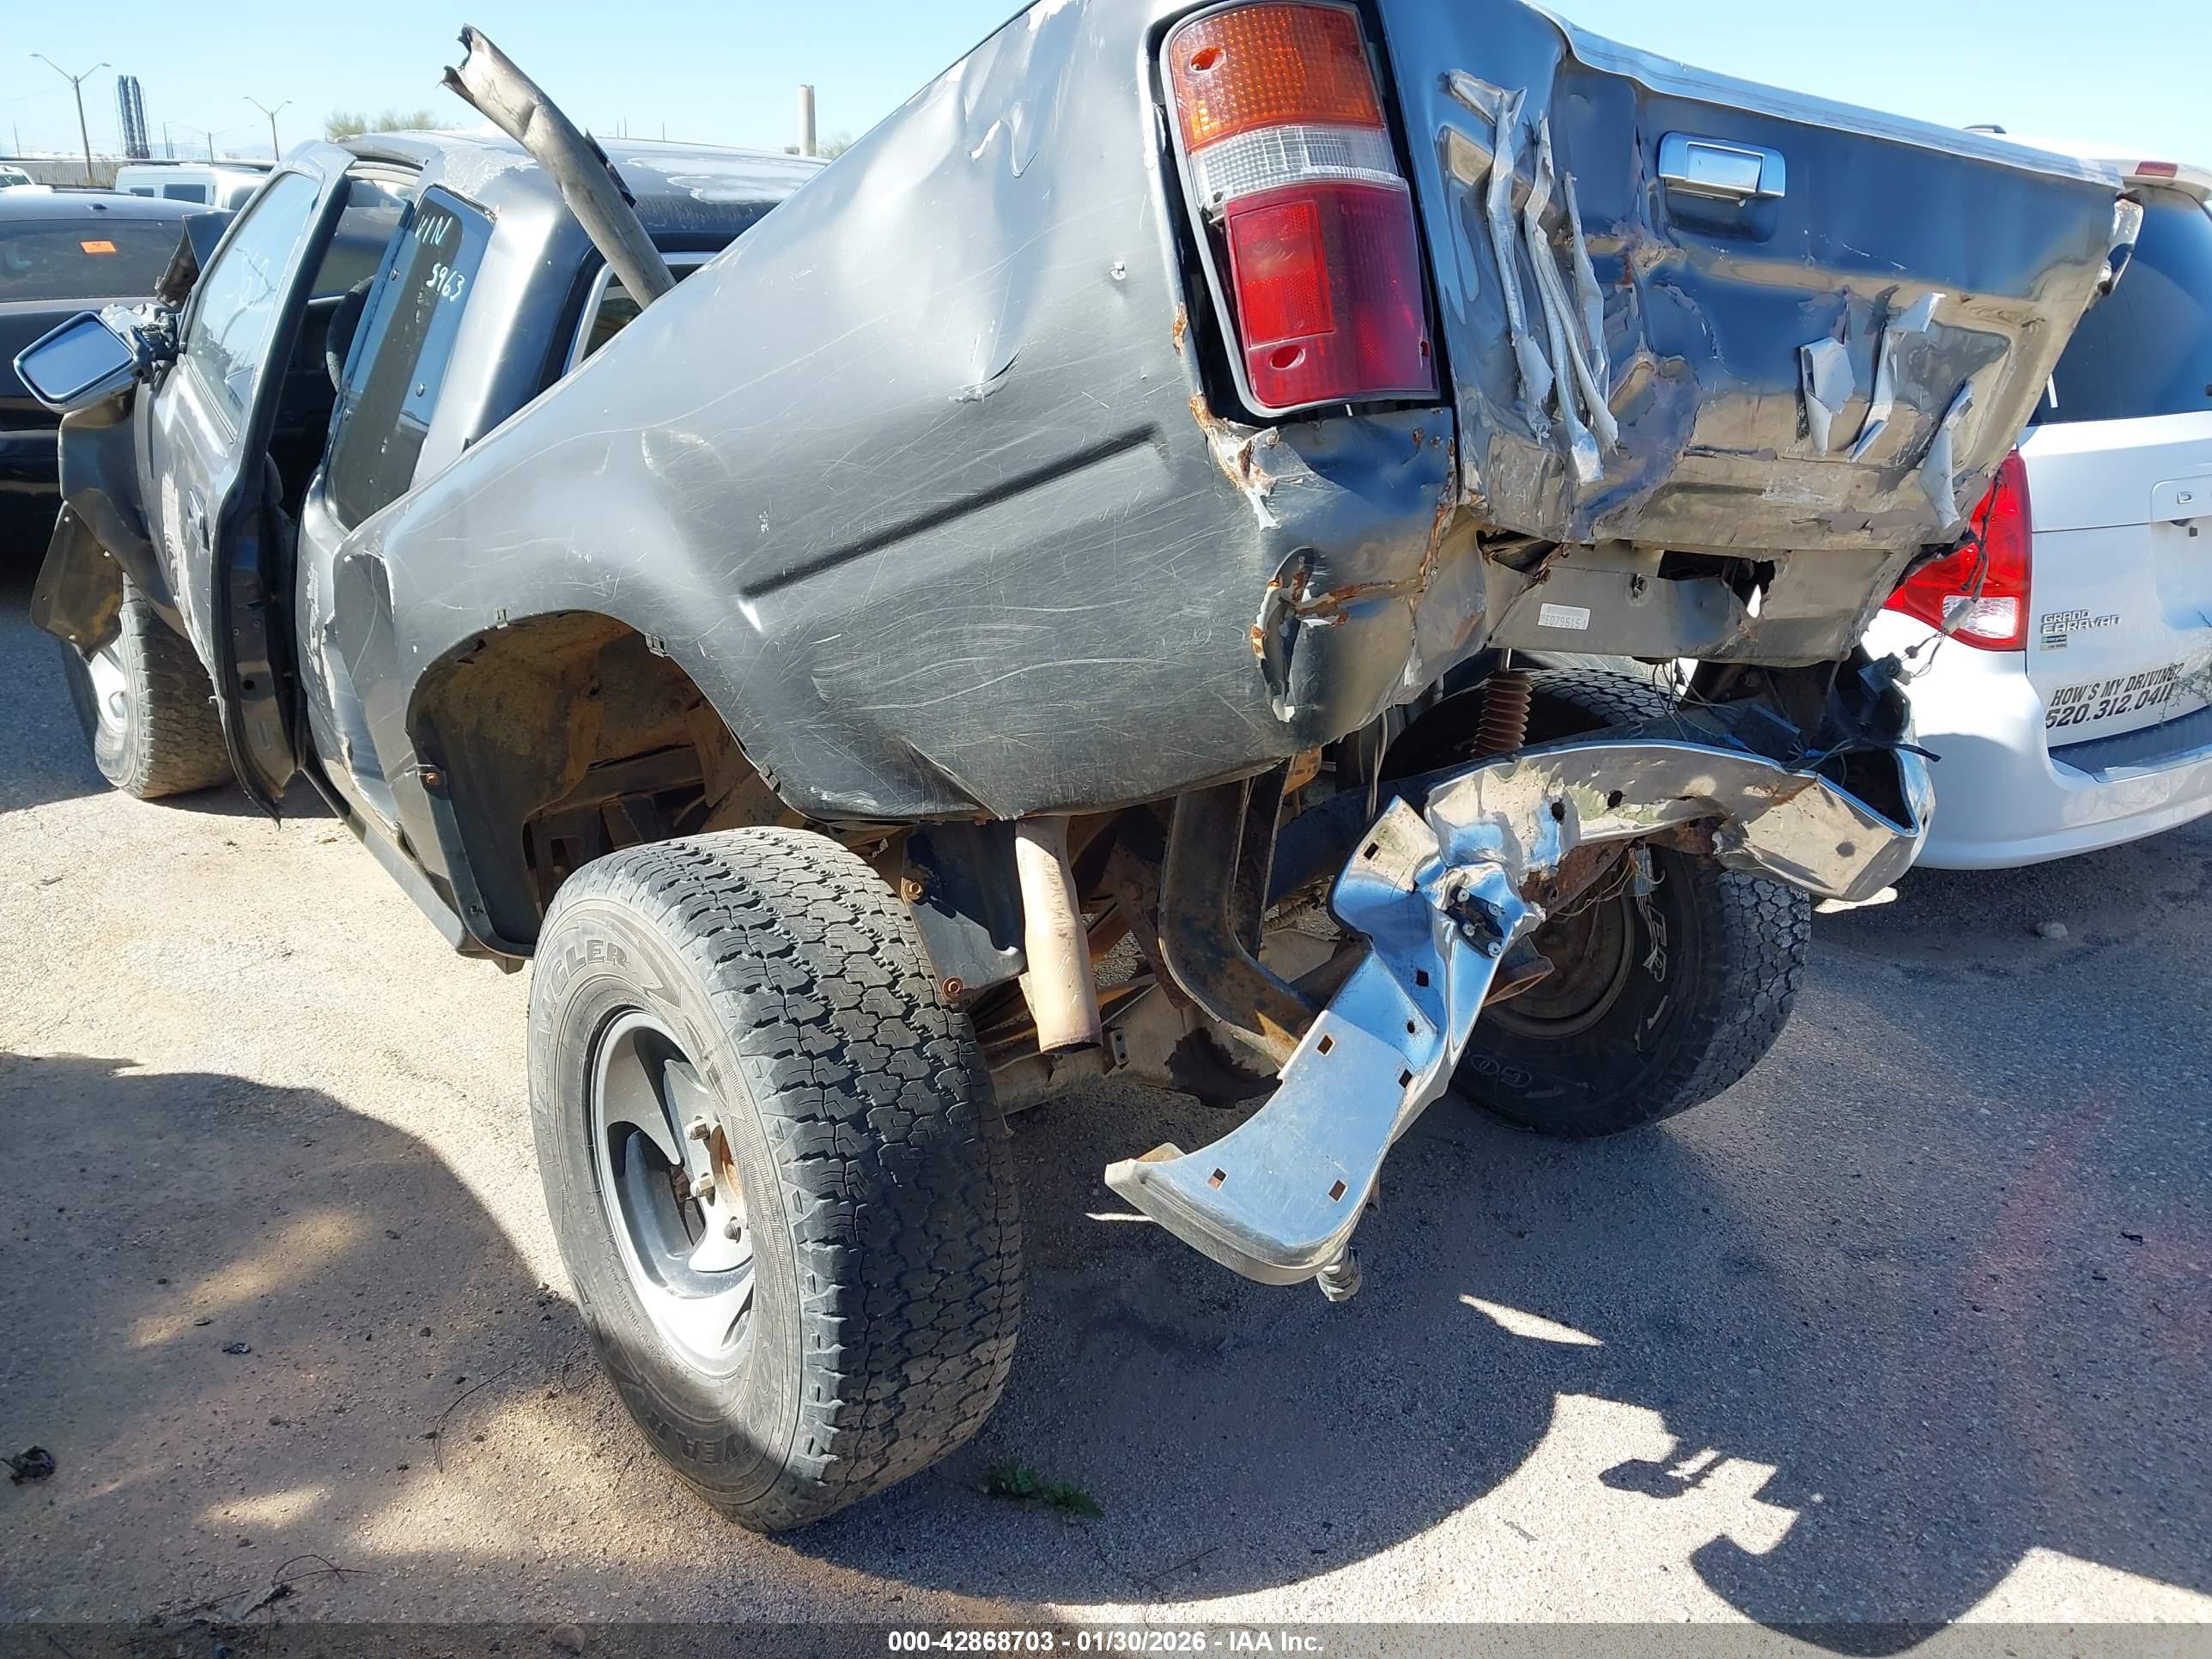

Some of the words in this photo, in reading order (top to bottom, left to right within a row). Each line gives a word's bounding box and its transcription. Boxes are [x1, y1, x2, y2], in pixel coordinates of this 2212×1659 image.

[415, 215, 453, 245] VIN
[426, 261, 465, 302] 5963
[2040, 614, 2122, 635] CARAVAN
[2041, 609, 2090, 625] GRAND
[2050, 683, 2100, 707] HOW'S
[2100, 678, 2124, 698] MY
